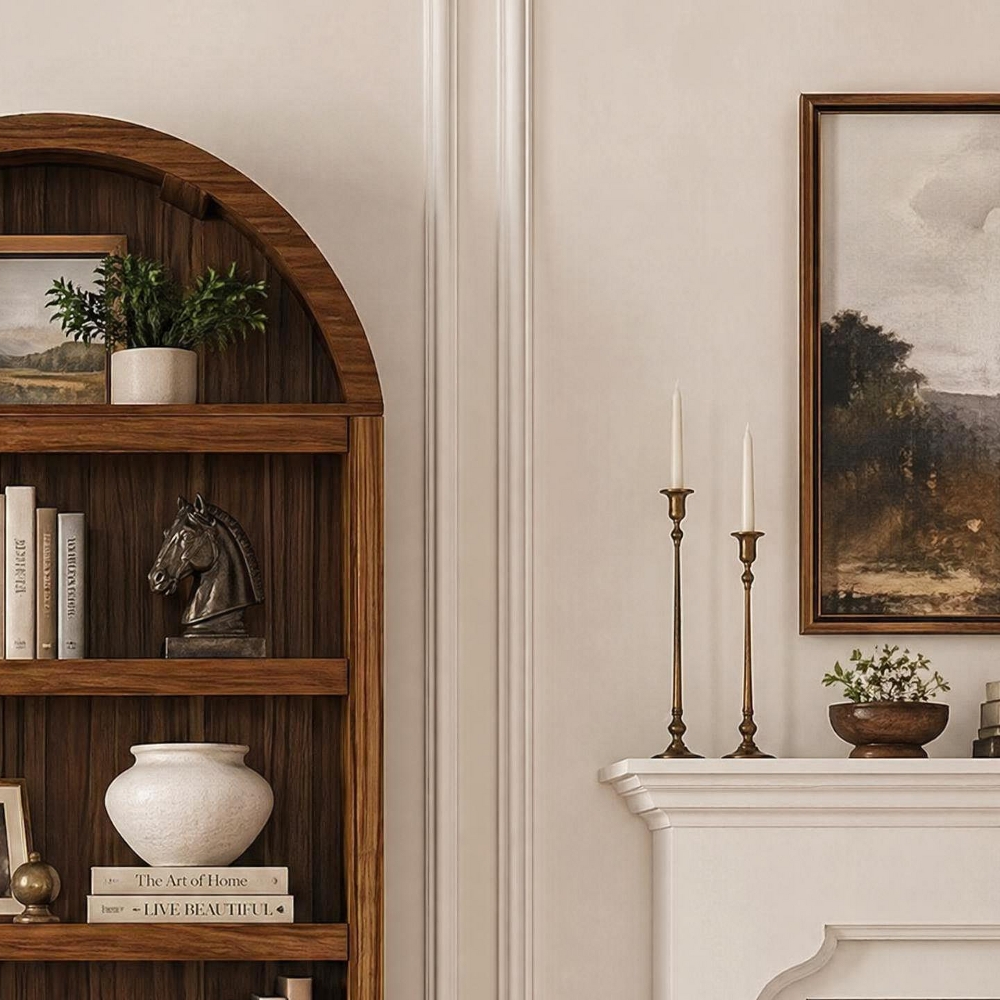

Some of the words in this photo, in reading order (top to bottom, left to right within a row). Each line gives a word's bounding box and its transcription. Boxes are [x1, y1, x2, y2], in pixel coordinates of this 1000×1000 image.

[135, 874, 163, 887] The
[166, 874, 187, 887] Art
[191, 873, 206, 887] of
[208, 874, 248, 887] Home
[144, 903, 180, 916] LIVE
[185, 903, 273, 916] BEAUTIFUL
